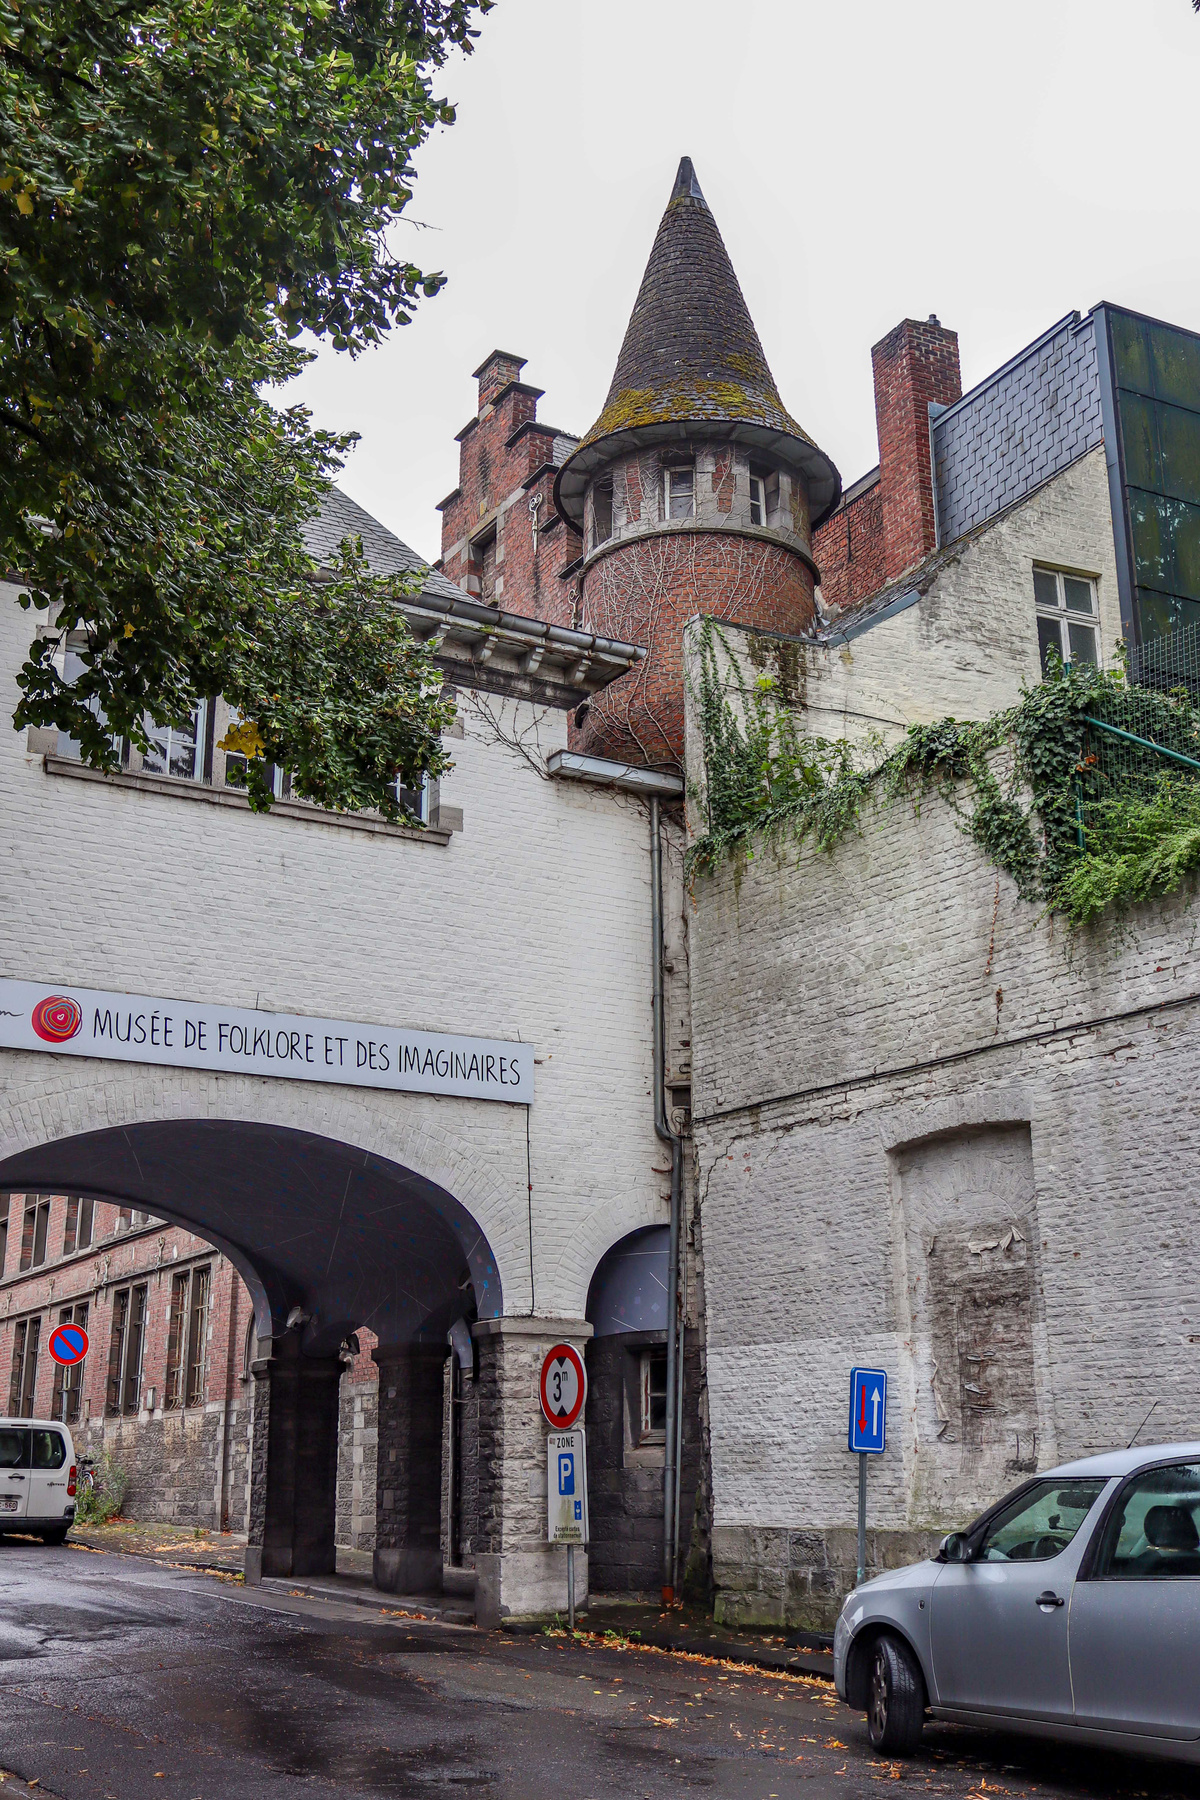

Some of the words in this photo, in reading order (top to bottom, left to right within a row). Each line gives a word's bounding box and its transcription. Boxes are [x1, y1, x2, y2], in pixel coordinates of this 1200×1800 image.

[93, 1007, 174, 1047] MUSÉE
[184, 1019, 208, 1051] DE
[218, 1022, 315, 1063] FOLKLORE
[324, 1035, 349, 1067] ET
[356, 1039, 390, 1072] DES
[398, 1044, 521, 1086] IMAGINAIRES
[556, 1437, 575, 1449] ZONE
[561, 1459, 571, 1490] P
